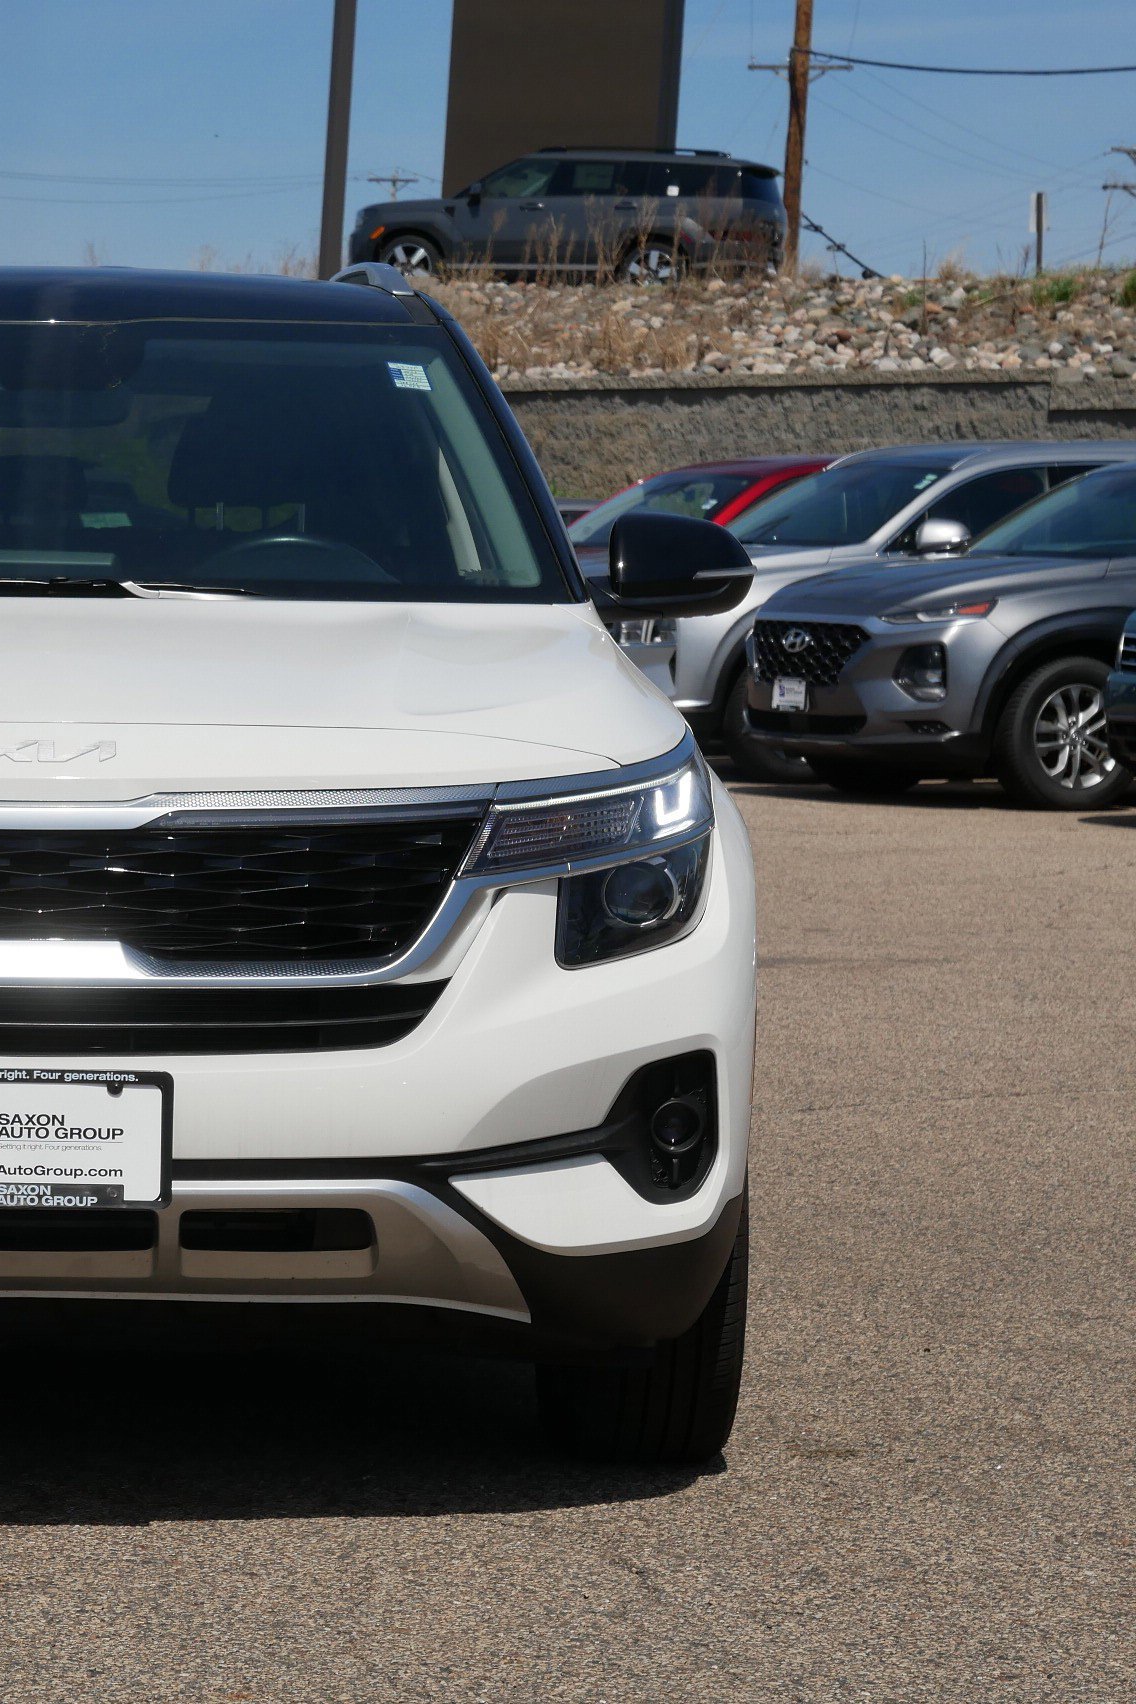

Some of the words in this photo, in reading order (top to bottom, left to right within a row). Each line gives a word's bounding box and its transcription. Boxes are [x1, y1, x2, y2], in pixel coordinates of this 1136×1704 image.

[0, 1070, 30, 1081] right.
[33, 1070, 61, 1080] Four
[64, 1072, 139, 1082] generations.
[54, 1127, 124, 1141] GROUP
[41, 1196, 98, 1207] GROUP
